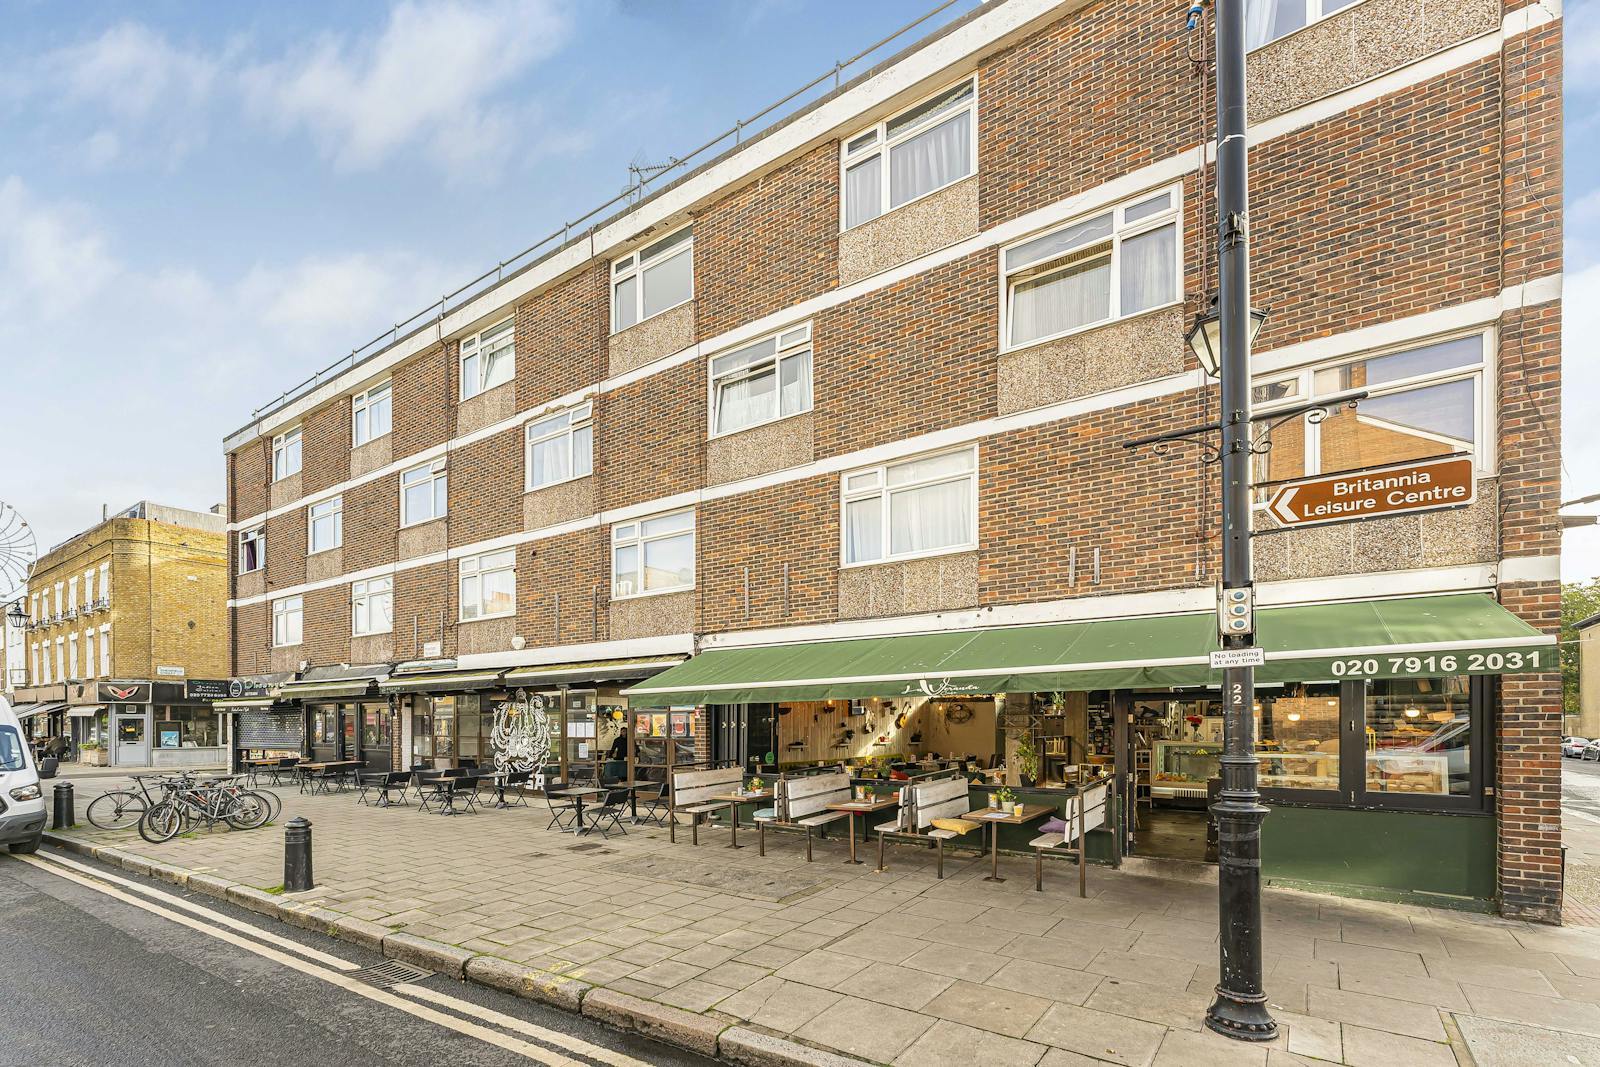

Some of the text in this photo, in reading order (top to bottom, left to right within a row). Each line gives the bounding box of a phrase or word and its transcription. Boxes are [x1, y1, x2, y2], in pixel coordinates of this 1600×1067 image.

[1333, 471, 1431, 496] Britannia
[1303, 485, 1466, 517] Leisure Centre
[1331, 650, 1541, 676] 020 7916 2031
